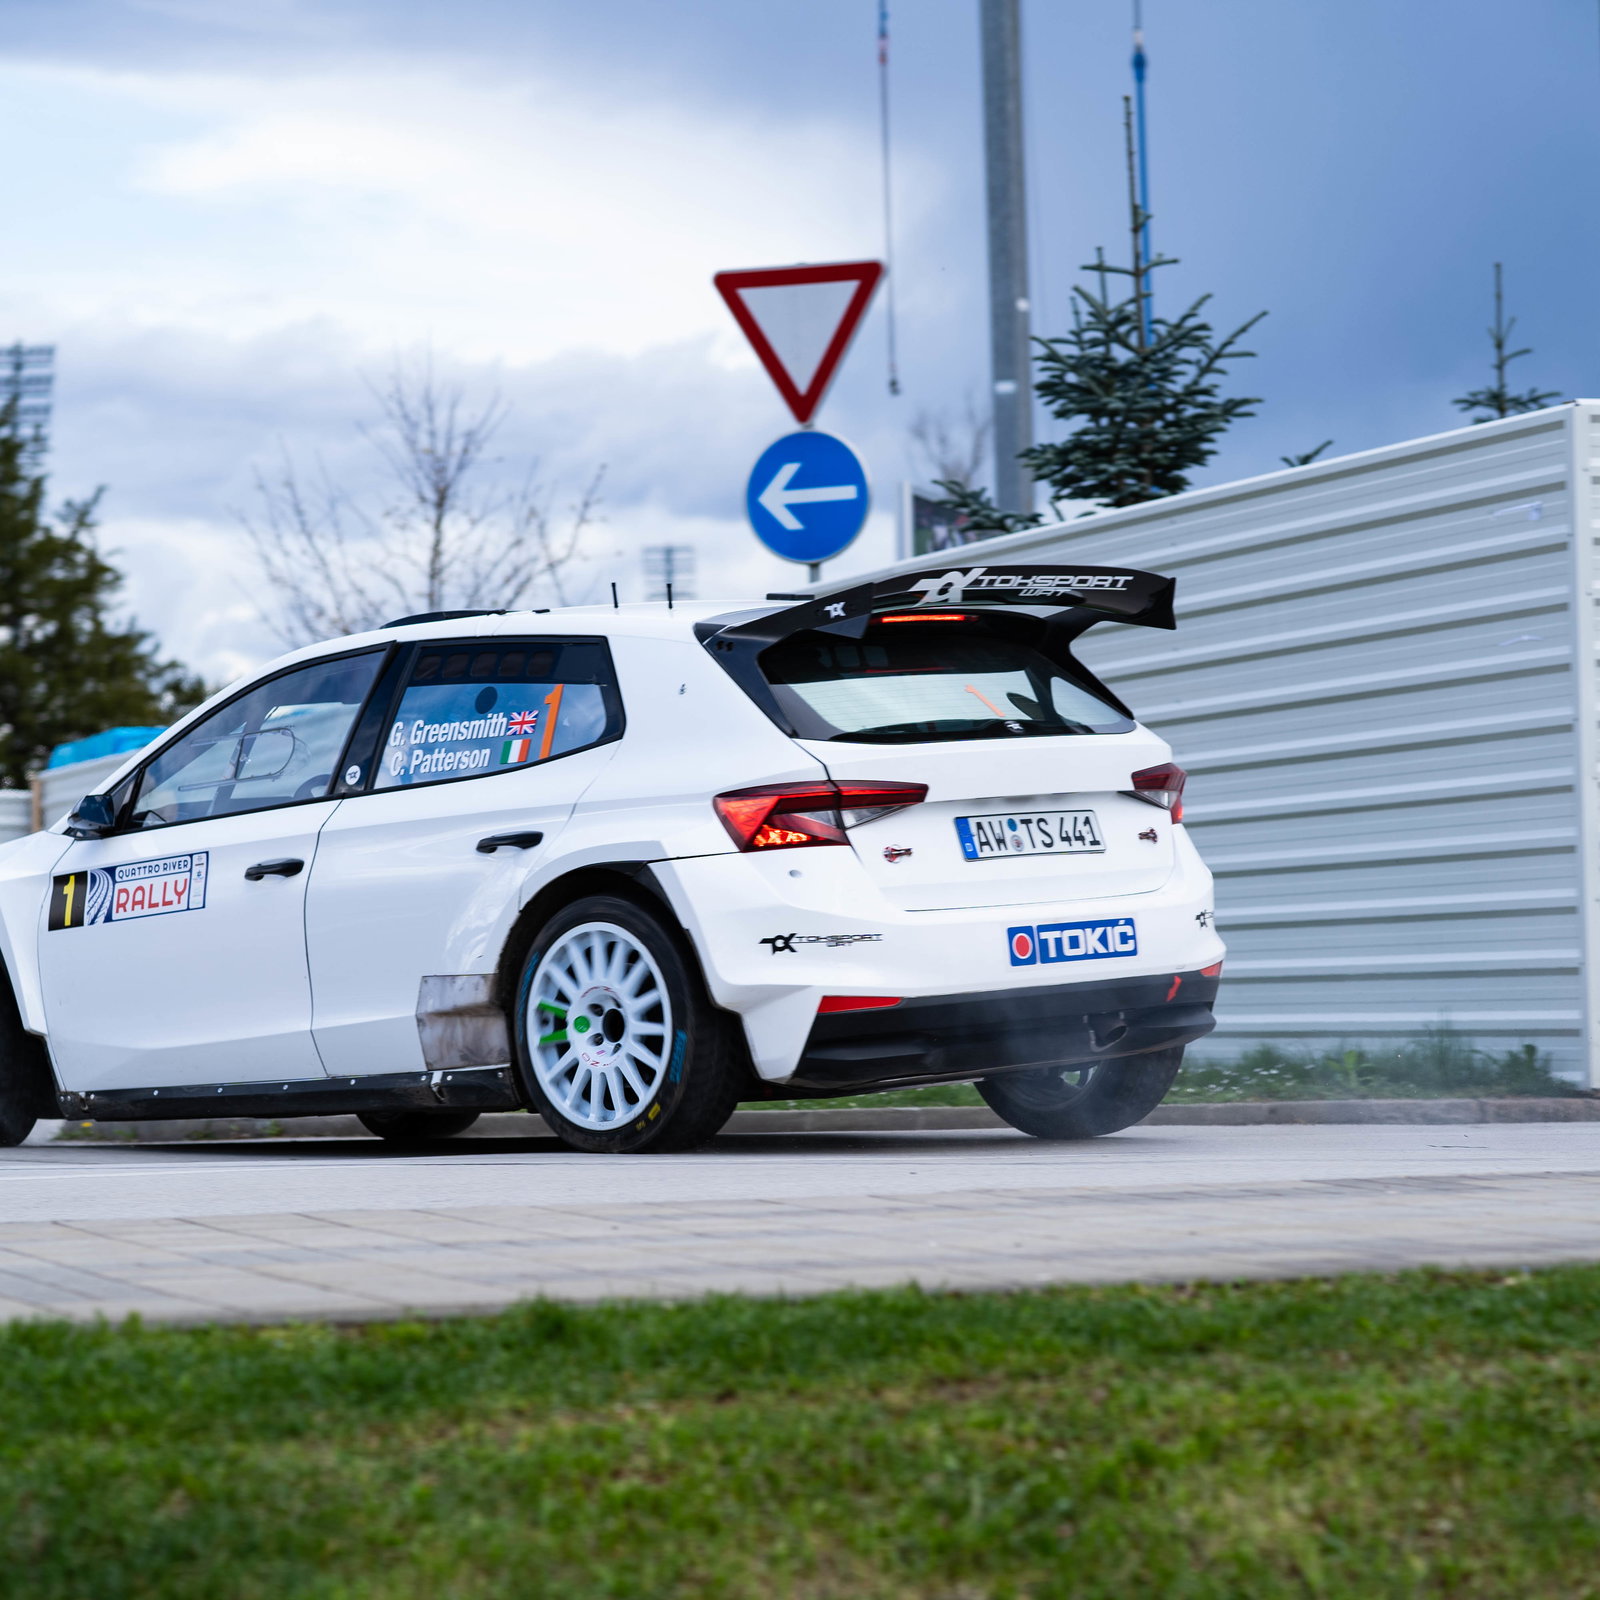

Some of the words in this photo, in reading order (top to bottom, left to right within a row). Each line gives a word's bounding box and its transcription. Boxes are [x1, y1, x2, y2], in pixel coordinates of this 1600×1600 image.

[977, 575, 1134, 588] TOKSPORT
[389, 721, 405, 747] G.
[410, 712, 508, 745] Greensmith
[538, 684, 564, 759] 1
[390, 751, 405, 777] C.
[409, 748, 491, 775] Patterson
[976, 820, 1008, 853] AW
[1020, 817, 1054, 849] TS
[1059, 815, 1101, 847] 441
[117, 863, 160, 880] QUATTRO
[163, 859, 189, 872] RIVER
[63, 875, 75, 927] 1
[115, 878, 188, 914] RALLY
[1039, 919, 1136, 958] TOKIĆ
